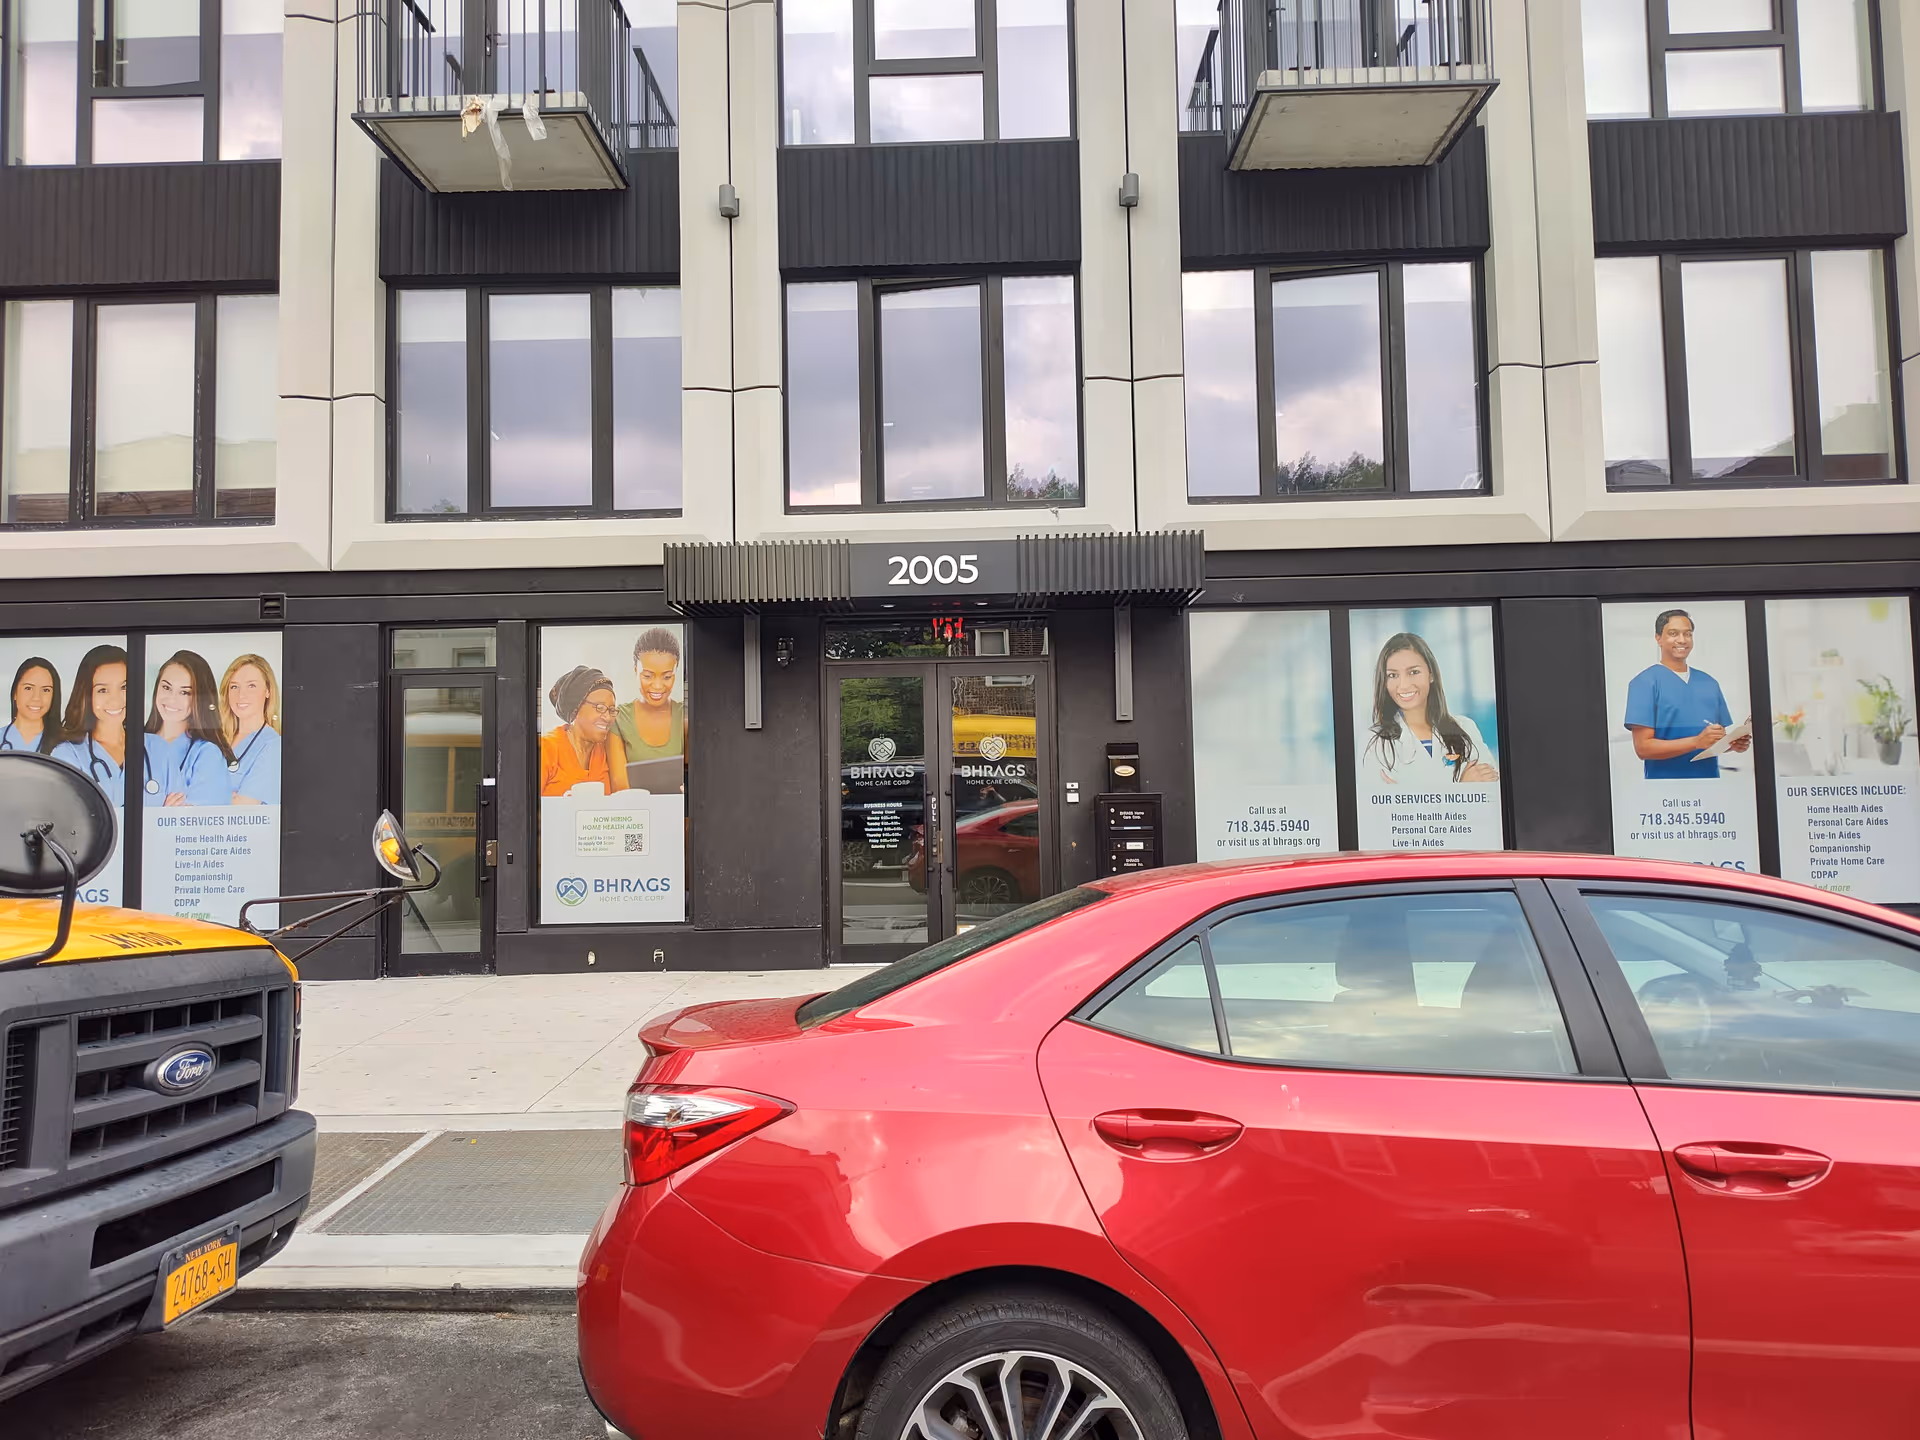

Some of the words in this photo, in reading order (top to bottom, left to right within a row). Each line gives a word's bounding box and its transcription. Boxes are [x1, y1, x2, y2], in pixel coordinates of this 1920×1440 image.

[888, 555, 979, 585] 2005
[851, 765, 915, 779] BHRAGS
[962, 764, 1025, 777] BHRAGS
[1787, 787, 1808, 797] OUR
[1811, 786, 1858, 796] SERVICES
[1860, 785, 1906, 796] INCLUDE:
[1372, 795, 1392, 805] OUR
[1395, 794, 1441, 804] SERVICES
[1662, 799, 1678, 808] Call
[1693, 799, 1701, 807] at
[1249, 806, 1264, 815] Call
[1279, 806, 1286, 814] at
[1807, 805, 1830, 814] Home
[1832, 804, 1859, 813] Health
[1861, 804, 1884, 813] Aides
[157, 817, 177, 827] OUR
[180, 816, 225, 826] SERVICES
[227, 815, 270, 825] INCLUDE:
[1391, 813, 1414, 821] Home
[1416, 812, 1442, 821] Health
[1445, 812, 1467, 821] Aides
[1640, 812, 1725, 826] 718.345.5940
[1227, 819, 1310, 832] 718.345.5940
[1808, 818, 1843, 827] Personal
[1845, 818, 1864, 826] Care
[1866, 817, 1888, 826] Aides
[1392, 826, 1426, 835] Personal
[1429, 825, 1447, 834] Care
[1450, 825, 1472, 833] Aides
[1630, 832, 1640, 840] or
[1642, 830, 1662, 840] visit
[1676, 830, 1685, 839] at
[1688, 830, 1736, 840] bhrags.org
[175, 835, 197, 843] Home
[199, 834, 224, 843] Health
[226, 834, 247, 842] Aides
[1808, 831, 1836, 840] Live-In
[1838, 831, 1861, 840] Aides
[1217, 839, 1226, 847] or
[1228, 838, 1248, 846] visit
[1262, 838, 1271, 846] at
[1273, 837, 1320, 847] bhrags.org
[1392, 839, 1420, 847] Live-In
[1422, 838, 1444, 847] Aides
[175, 847, 208, 856] Personal
[210, 847, 228, 855] Care
[230, 847, 251, 855] Aides
[1809, 844, 1871, 854] Companionship
[175, 860, 201, 869] Live-In
[203, 860, 225, 868] Aides
[1810, 857, 1838, 866] Private
[1841, 857, 1864, 866] Home
[1866, 856, 1885, 865] Care
[175, 873, 233, 882] Companionship
[1811, 870, 1838, 879] CDPAP
[174, 885, 201, 894] Private
[203, 885, 226, 894] Home
[228, 885, 245, 893] Care
[594, 878, 670, 892] BHRAGS
[174, 898, 200, 907] CDPAP
[175, 1057, 205, 1082] Ford
[185, 1246, 202, 1263] NEW
[203, 1238, 222, 1253] YORK
